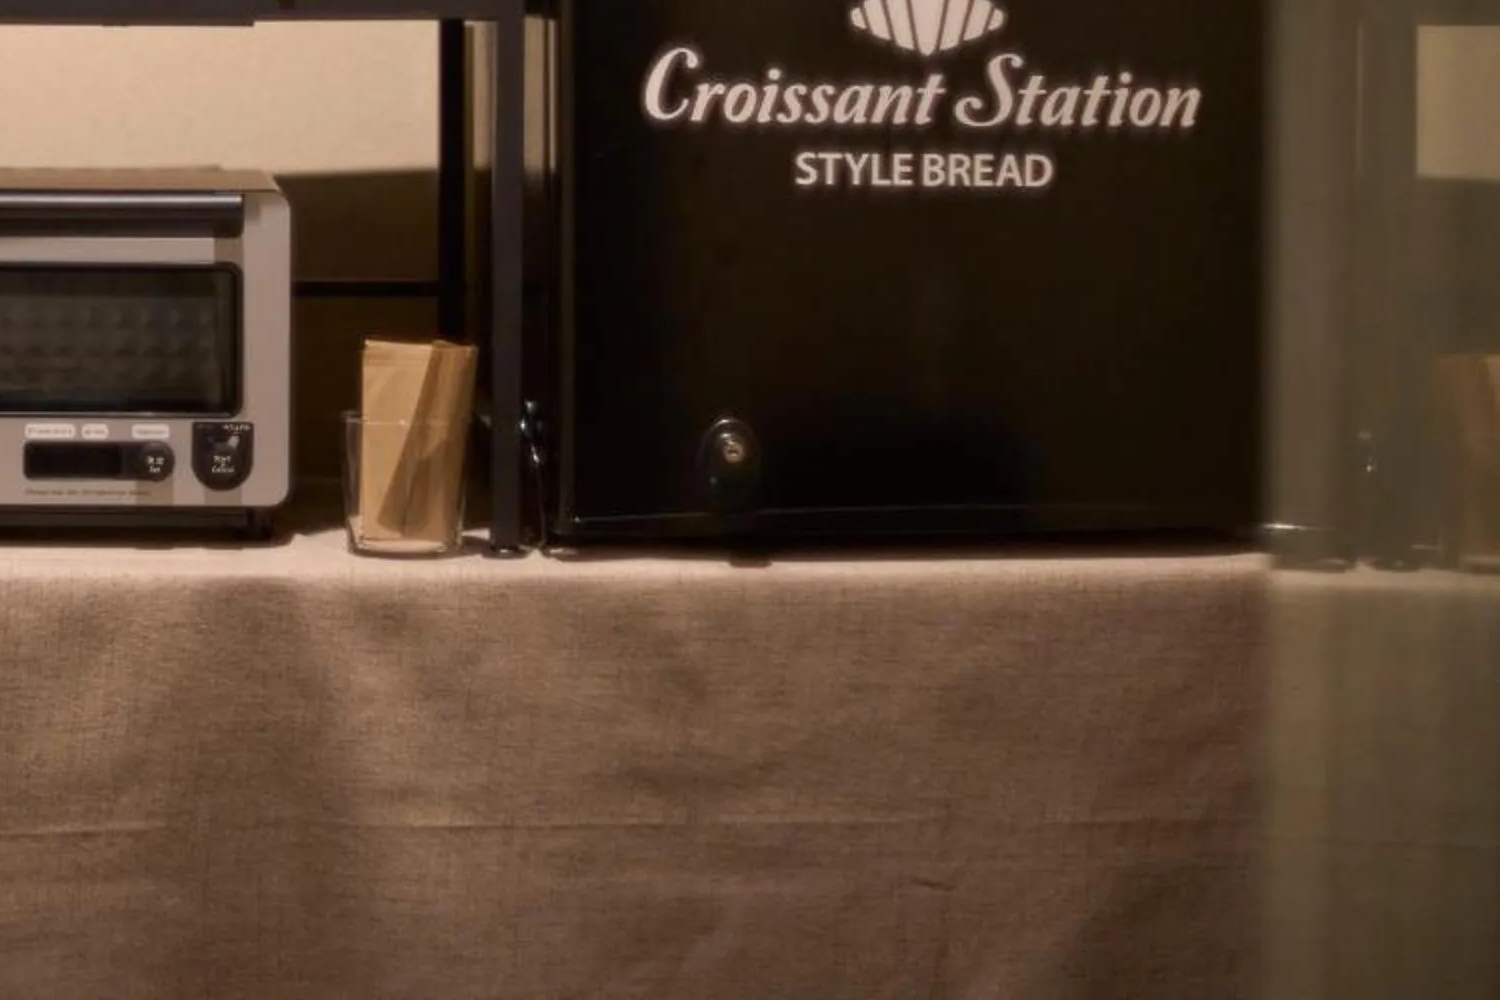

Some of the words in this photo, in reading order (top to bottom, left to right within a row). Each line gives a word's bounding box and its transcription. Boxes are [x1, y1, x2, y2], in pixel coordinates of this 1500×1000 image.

[644, 47, 946, 126] Croissant
[953, 53, 1202, 128] Station
[795, 151, 914, 187] STYLE
[921, 152, 1054, 188] BREAD
